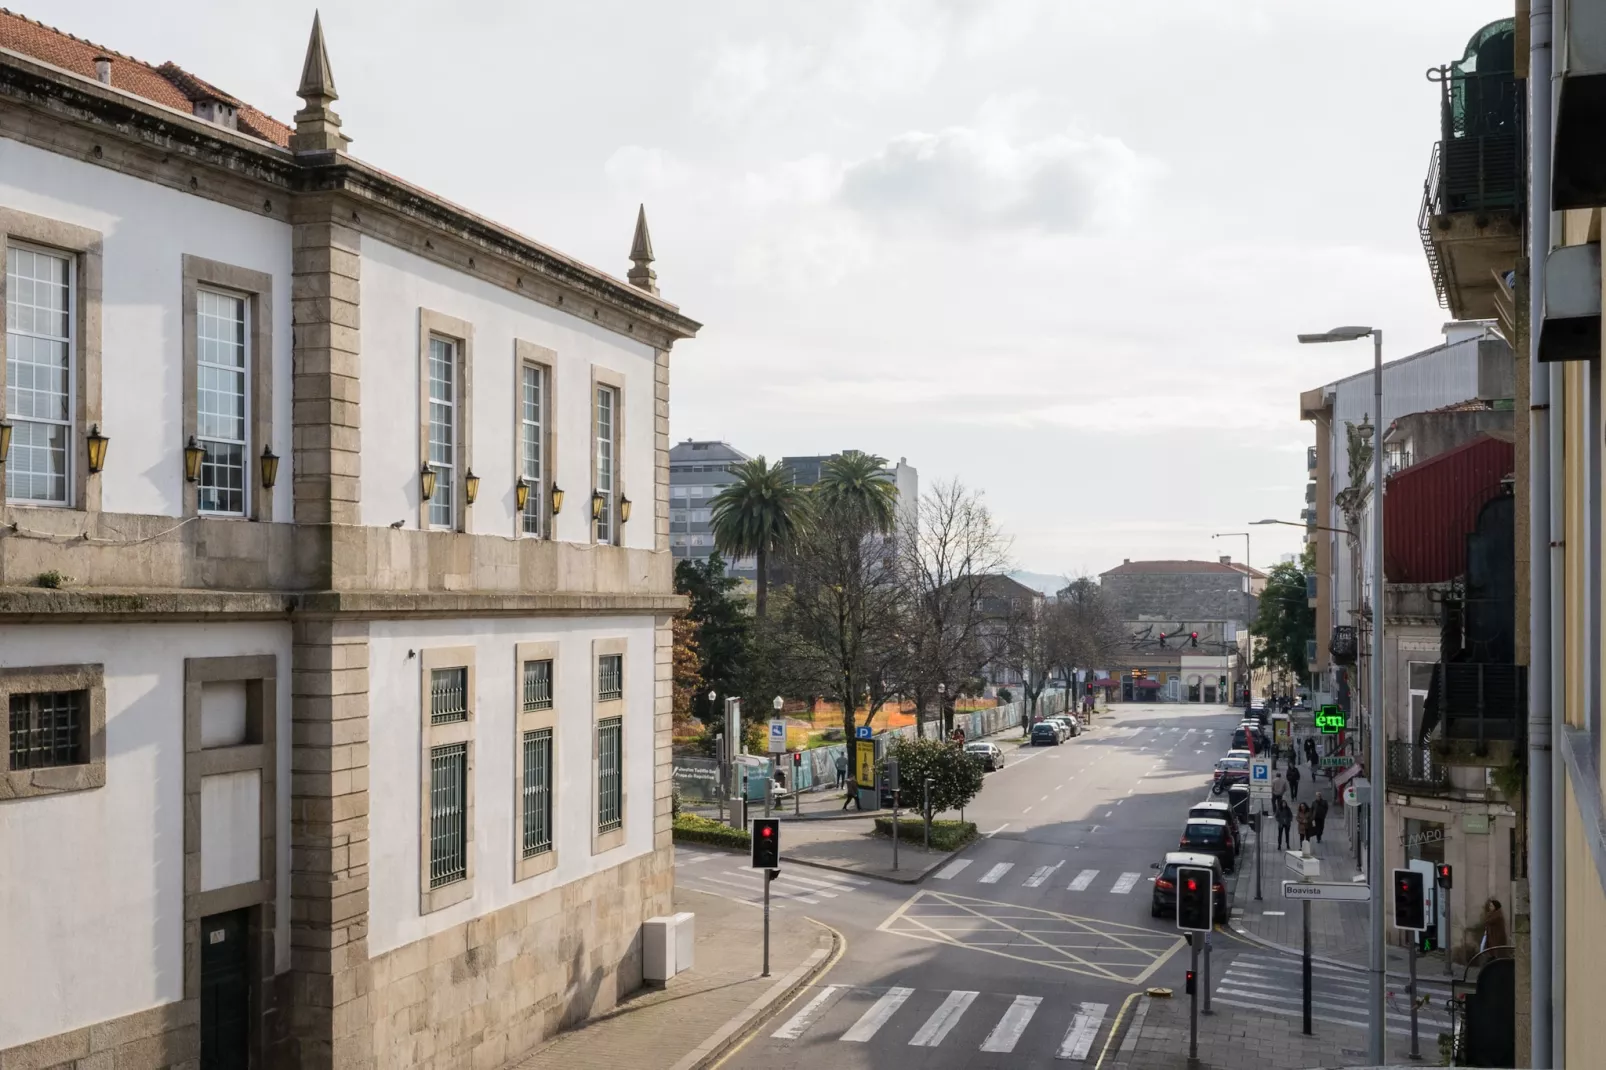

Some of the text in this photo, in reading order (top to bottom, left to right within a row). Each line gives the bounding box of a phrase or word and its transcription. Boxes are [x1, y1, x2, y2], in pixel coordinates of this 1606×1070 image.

[860, 728, 869, 738] P
[1255, 766, 1265, 778] P
[1286, 886, 1321, 895] Boavista
